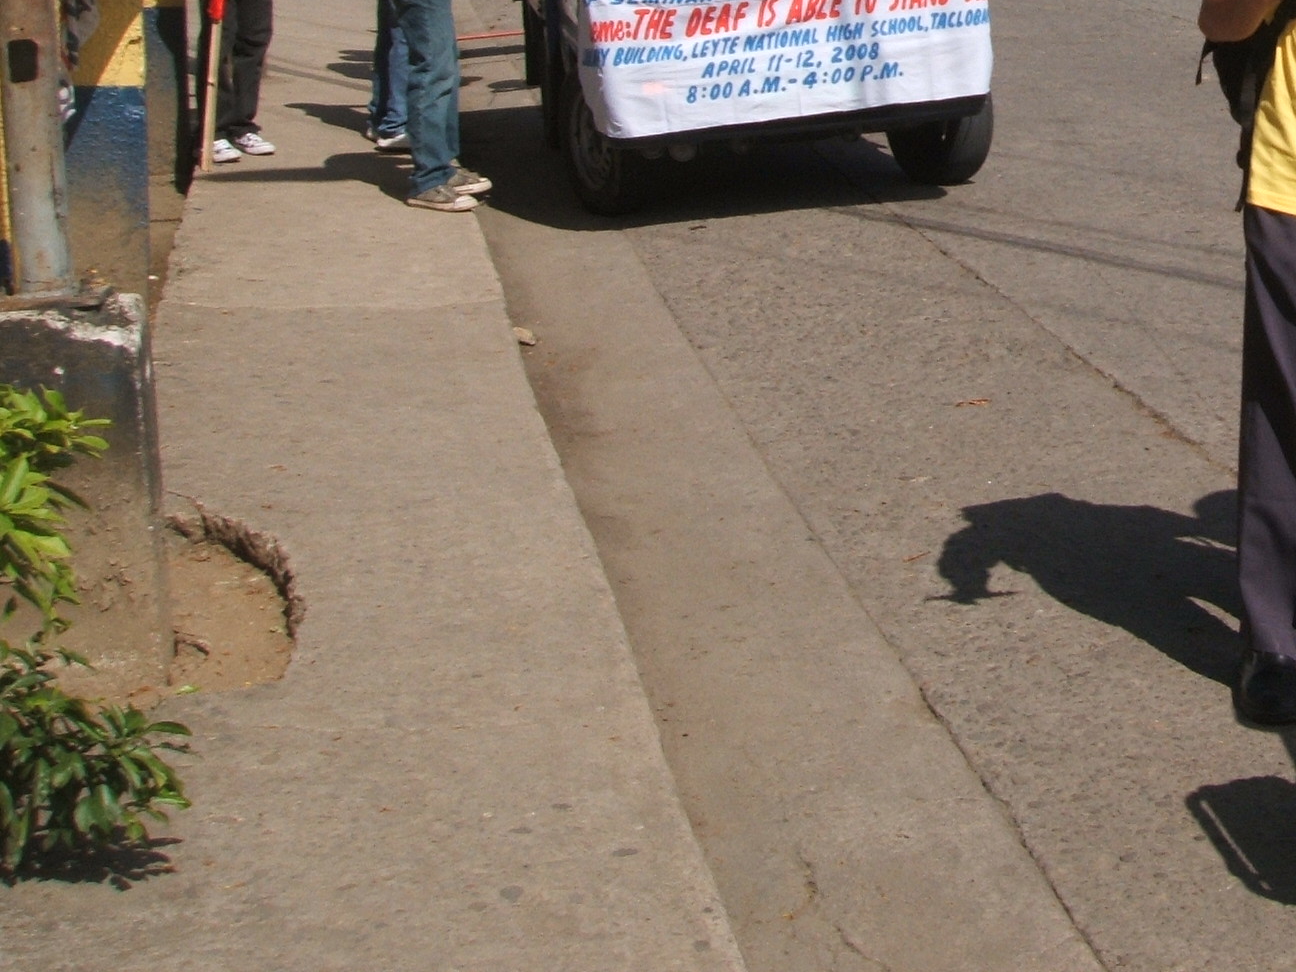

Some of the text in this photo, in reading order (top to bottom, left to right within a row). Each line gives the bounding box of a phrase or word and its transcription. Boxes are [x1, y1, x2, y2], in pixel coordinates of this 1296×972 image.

[685, 1, 749, 38] DEAF
[691, 35, 741, 59] LEYTE
[743, 28, 818, 52] NATIONAL
[826, 22, 865, 43] HIGH
[702, 42, 880, 79] APRIL 11-12, 2008
[686, 79, 733, 104] 8:00
[860, 61, 904, 83] P.M.
